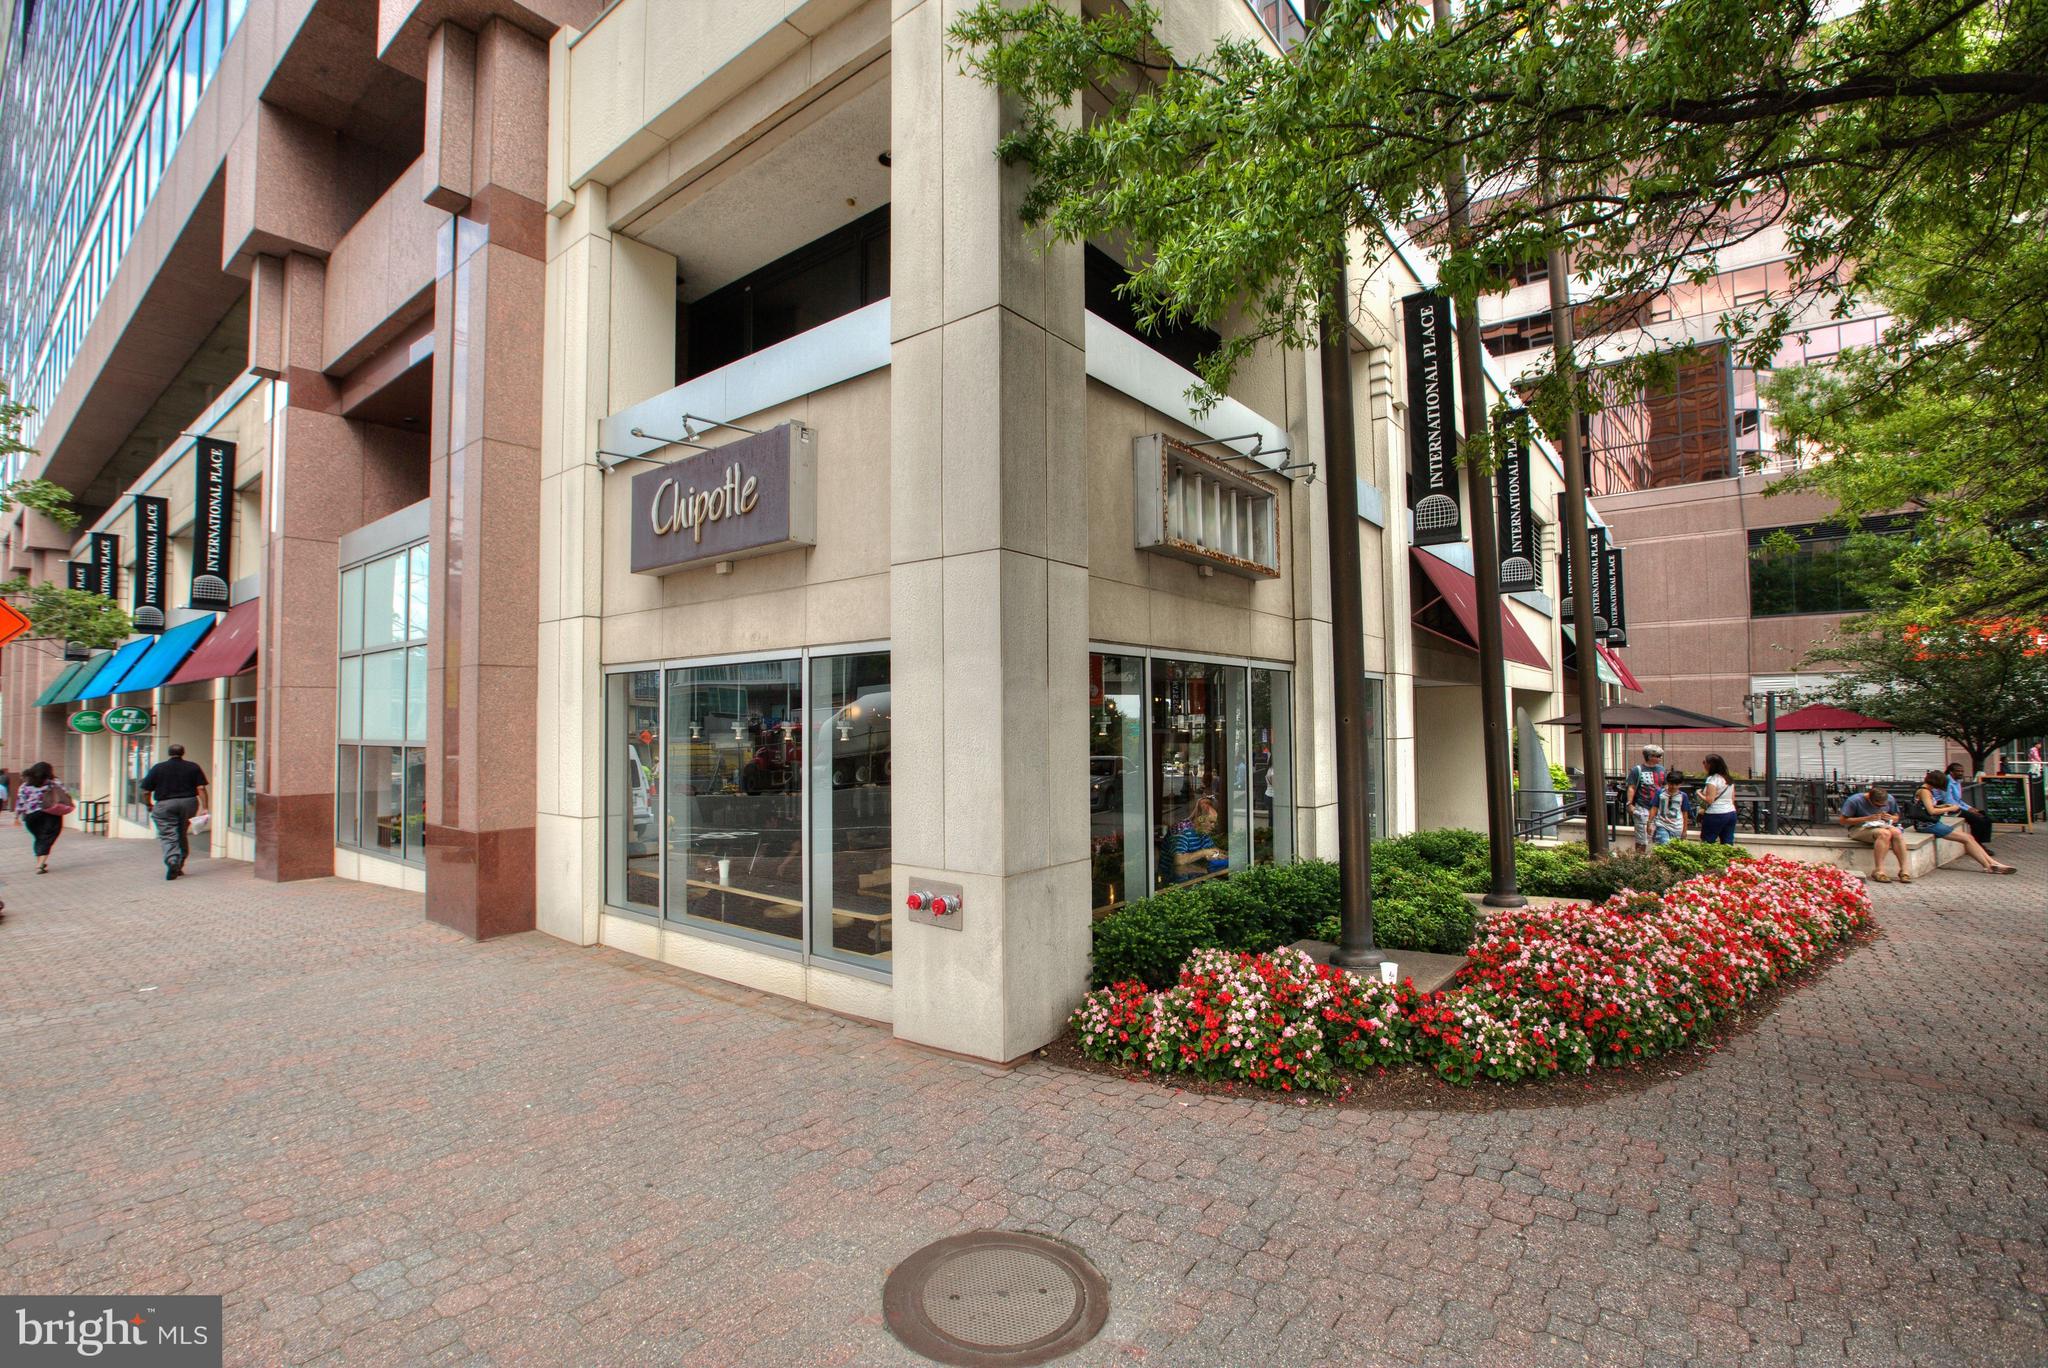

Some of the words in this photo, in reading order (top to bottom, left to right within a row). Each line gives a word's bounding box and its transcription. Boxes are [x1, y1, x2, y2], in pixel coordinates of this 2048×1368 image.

[1420, 305, 1437, 359] PLACE
[1424, 361, 1443, 488] INTERNATIONAL
[210, 448, 223, 483] PLACE
[146, 504, 159, 533] PLACE
[207, 484, 222, 572] INTERNATIONAL
[651, 462, 759, 544] Chipotle
[1508, 461, 1522, 553] INTERNATIONAL
[101, 540, 111, 564] PLACE
[145, 533, 158, 603] INTERNATIONAL
[1590, 533, 1599, 558] PLACE
[1608, 555, 1616, 576] PLACE
[1591, 558, 1601, 615] INTERNATIONAL
[1608, 575, 1618, 626] INTERNATIONAL
